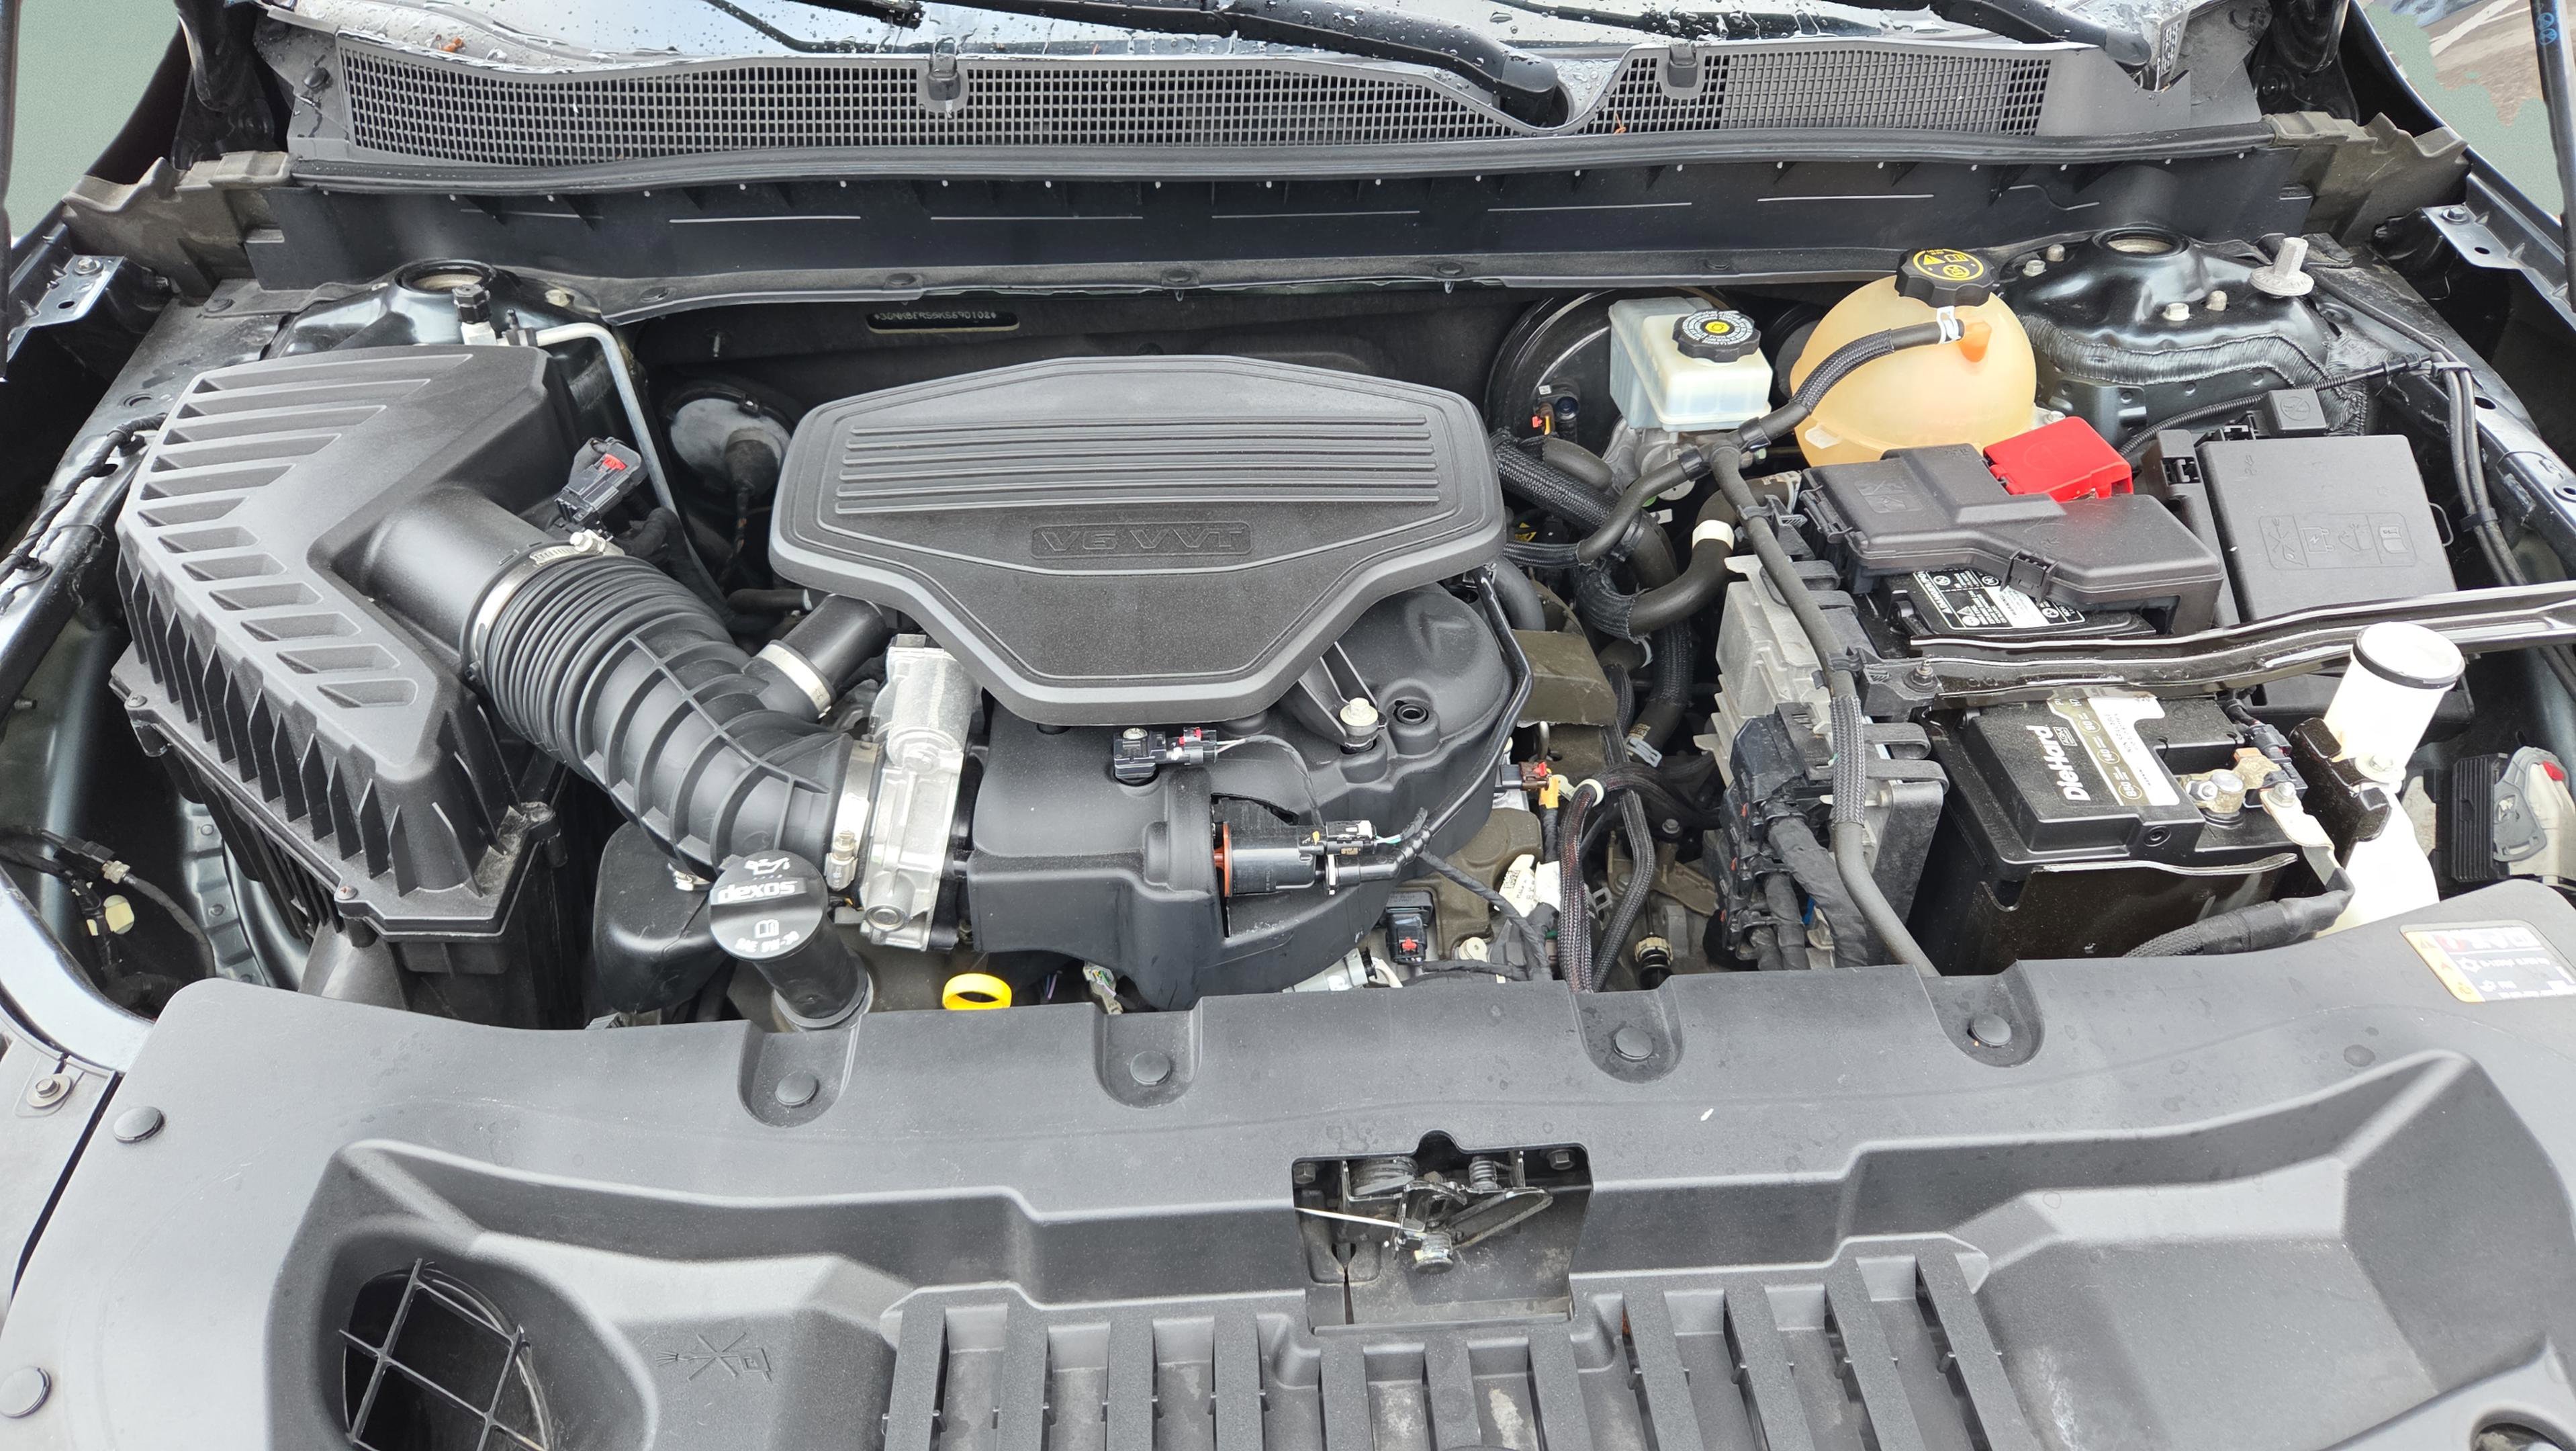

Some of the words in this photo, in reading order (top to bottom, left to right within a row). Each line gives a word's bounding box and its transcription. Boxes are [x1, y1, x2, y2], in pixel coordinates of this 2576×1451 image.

[1042, 531, 1117, 552] V6
[1130, 529, 1242, 549] VVT
[2025, 725, 2091, 801] DieHard
[718, 880, 798, 904] dexos
